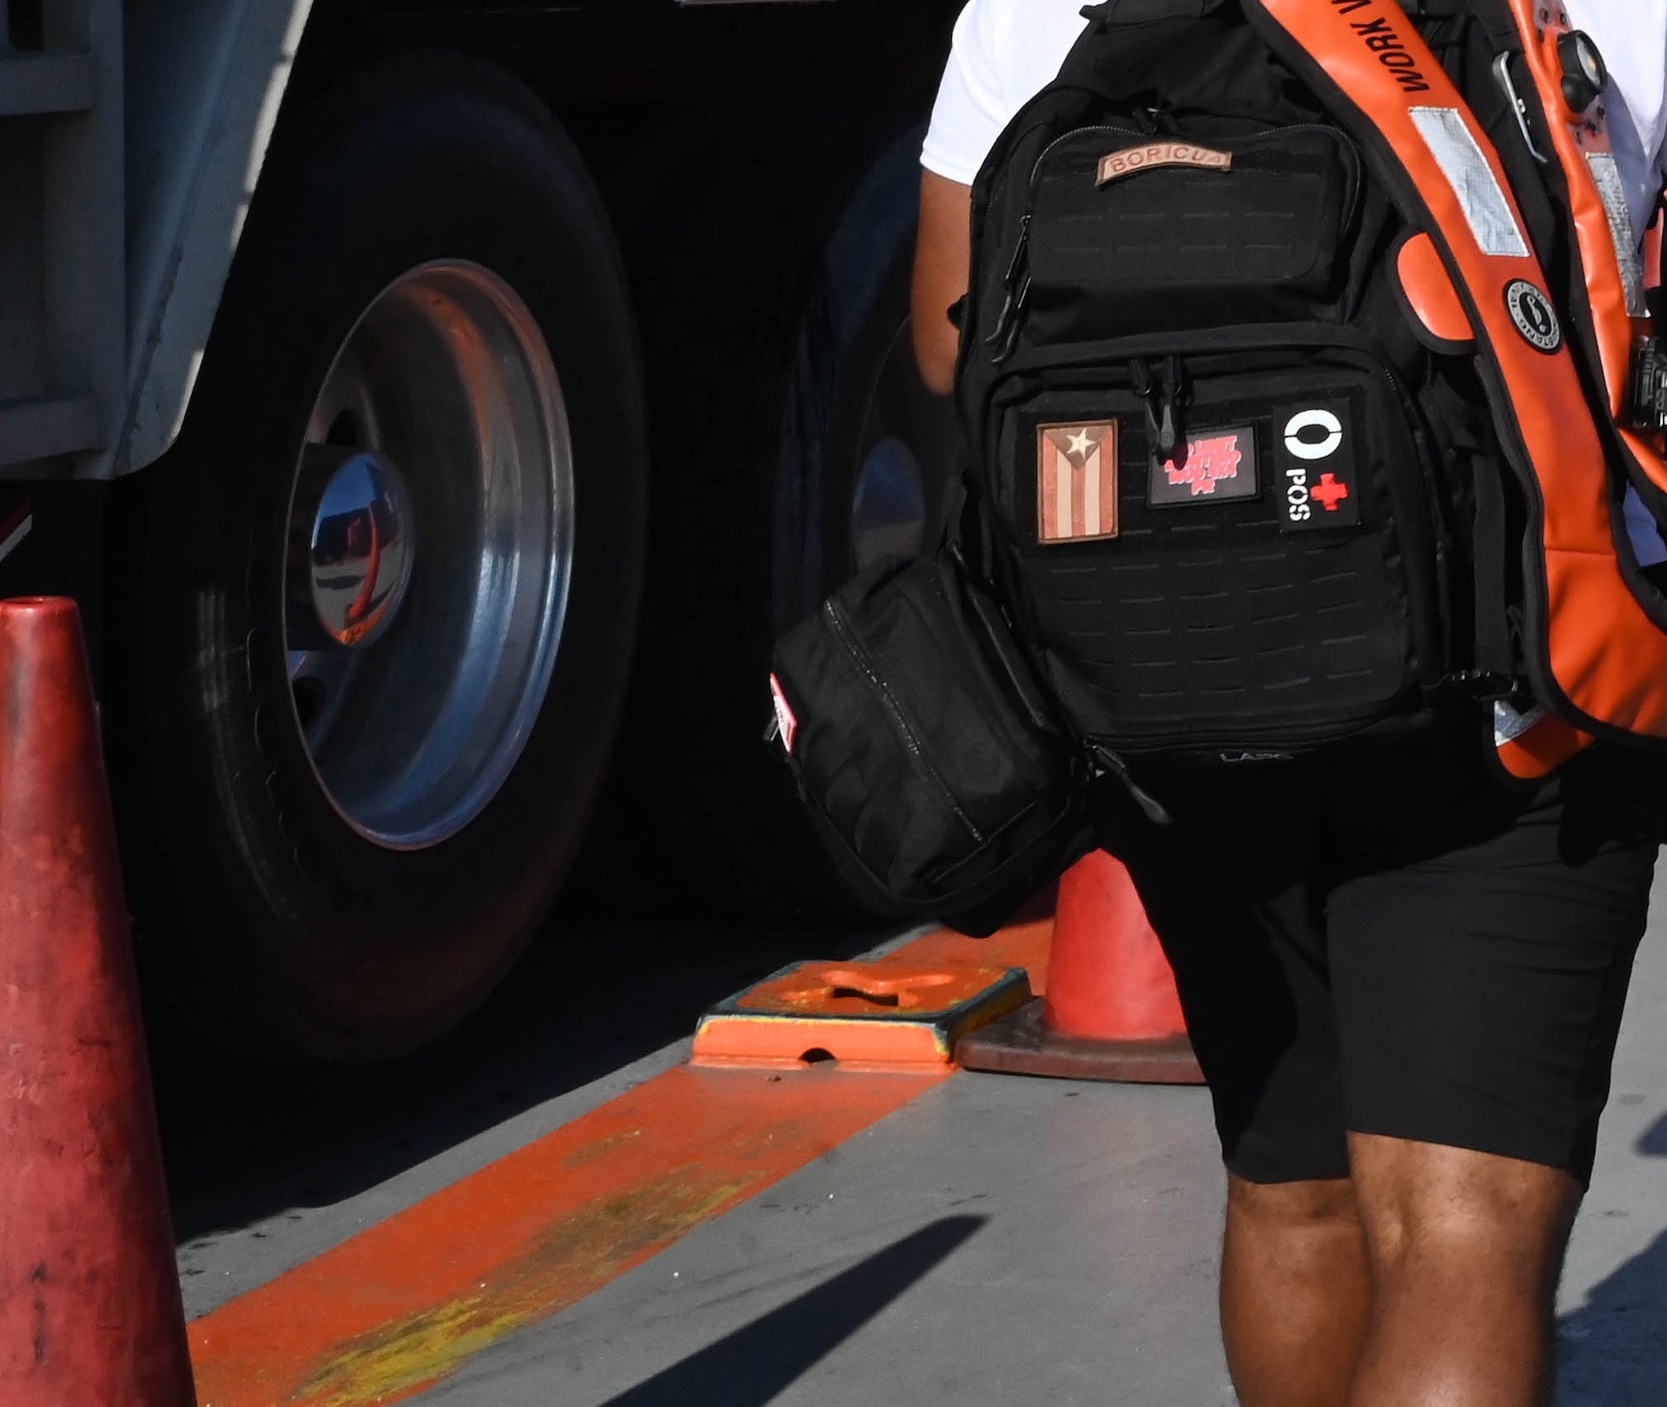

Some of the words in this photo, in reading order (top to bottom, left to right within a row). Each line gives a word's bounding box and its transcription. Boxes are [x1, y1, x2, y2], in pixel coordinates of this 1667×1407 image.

[1350, 17, 1430, 92] WORK
[1109, 145, 1221, 173] BORICUA
[1284, 409, 1342, 460] O
[1286, 468, 1311, 522] POS
